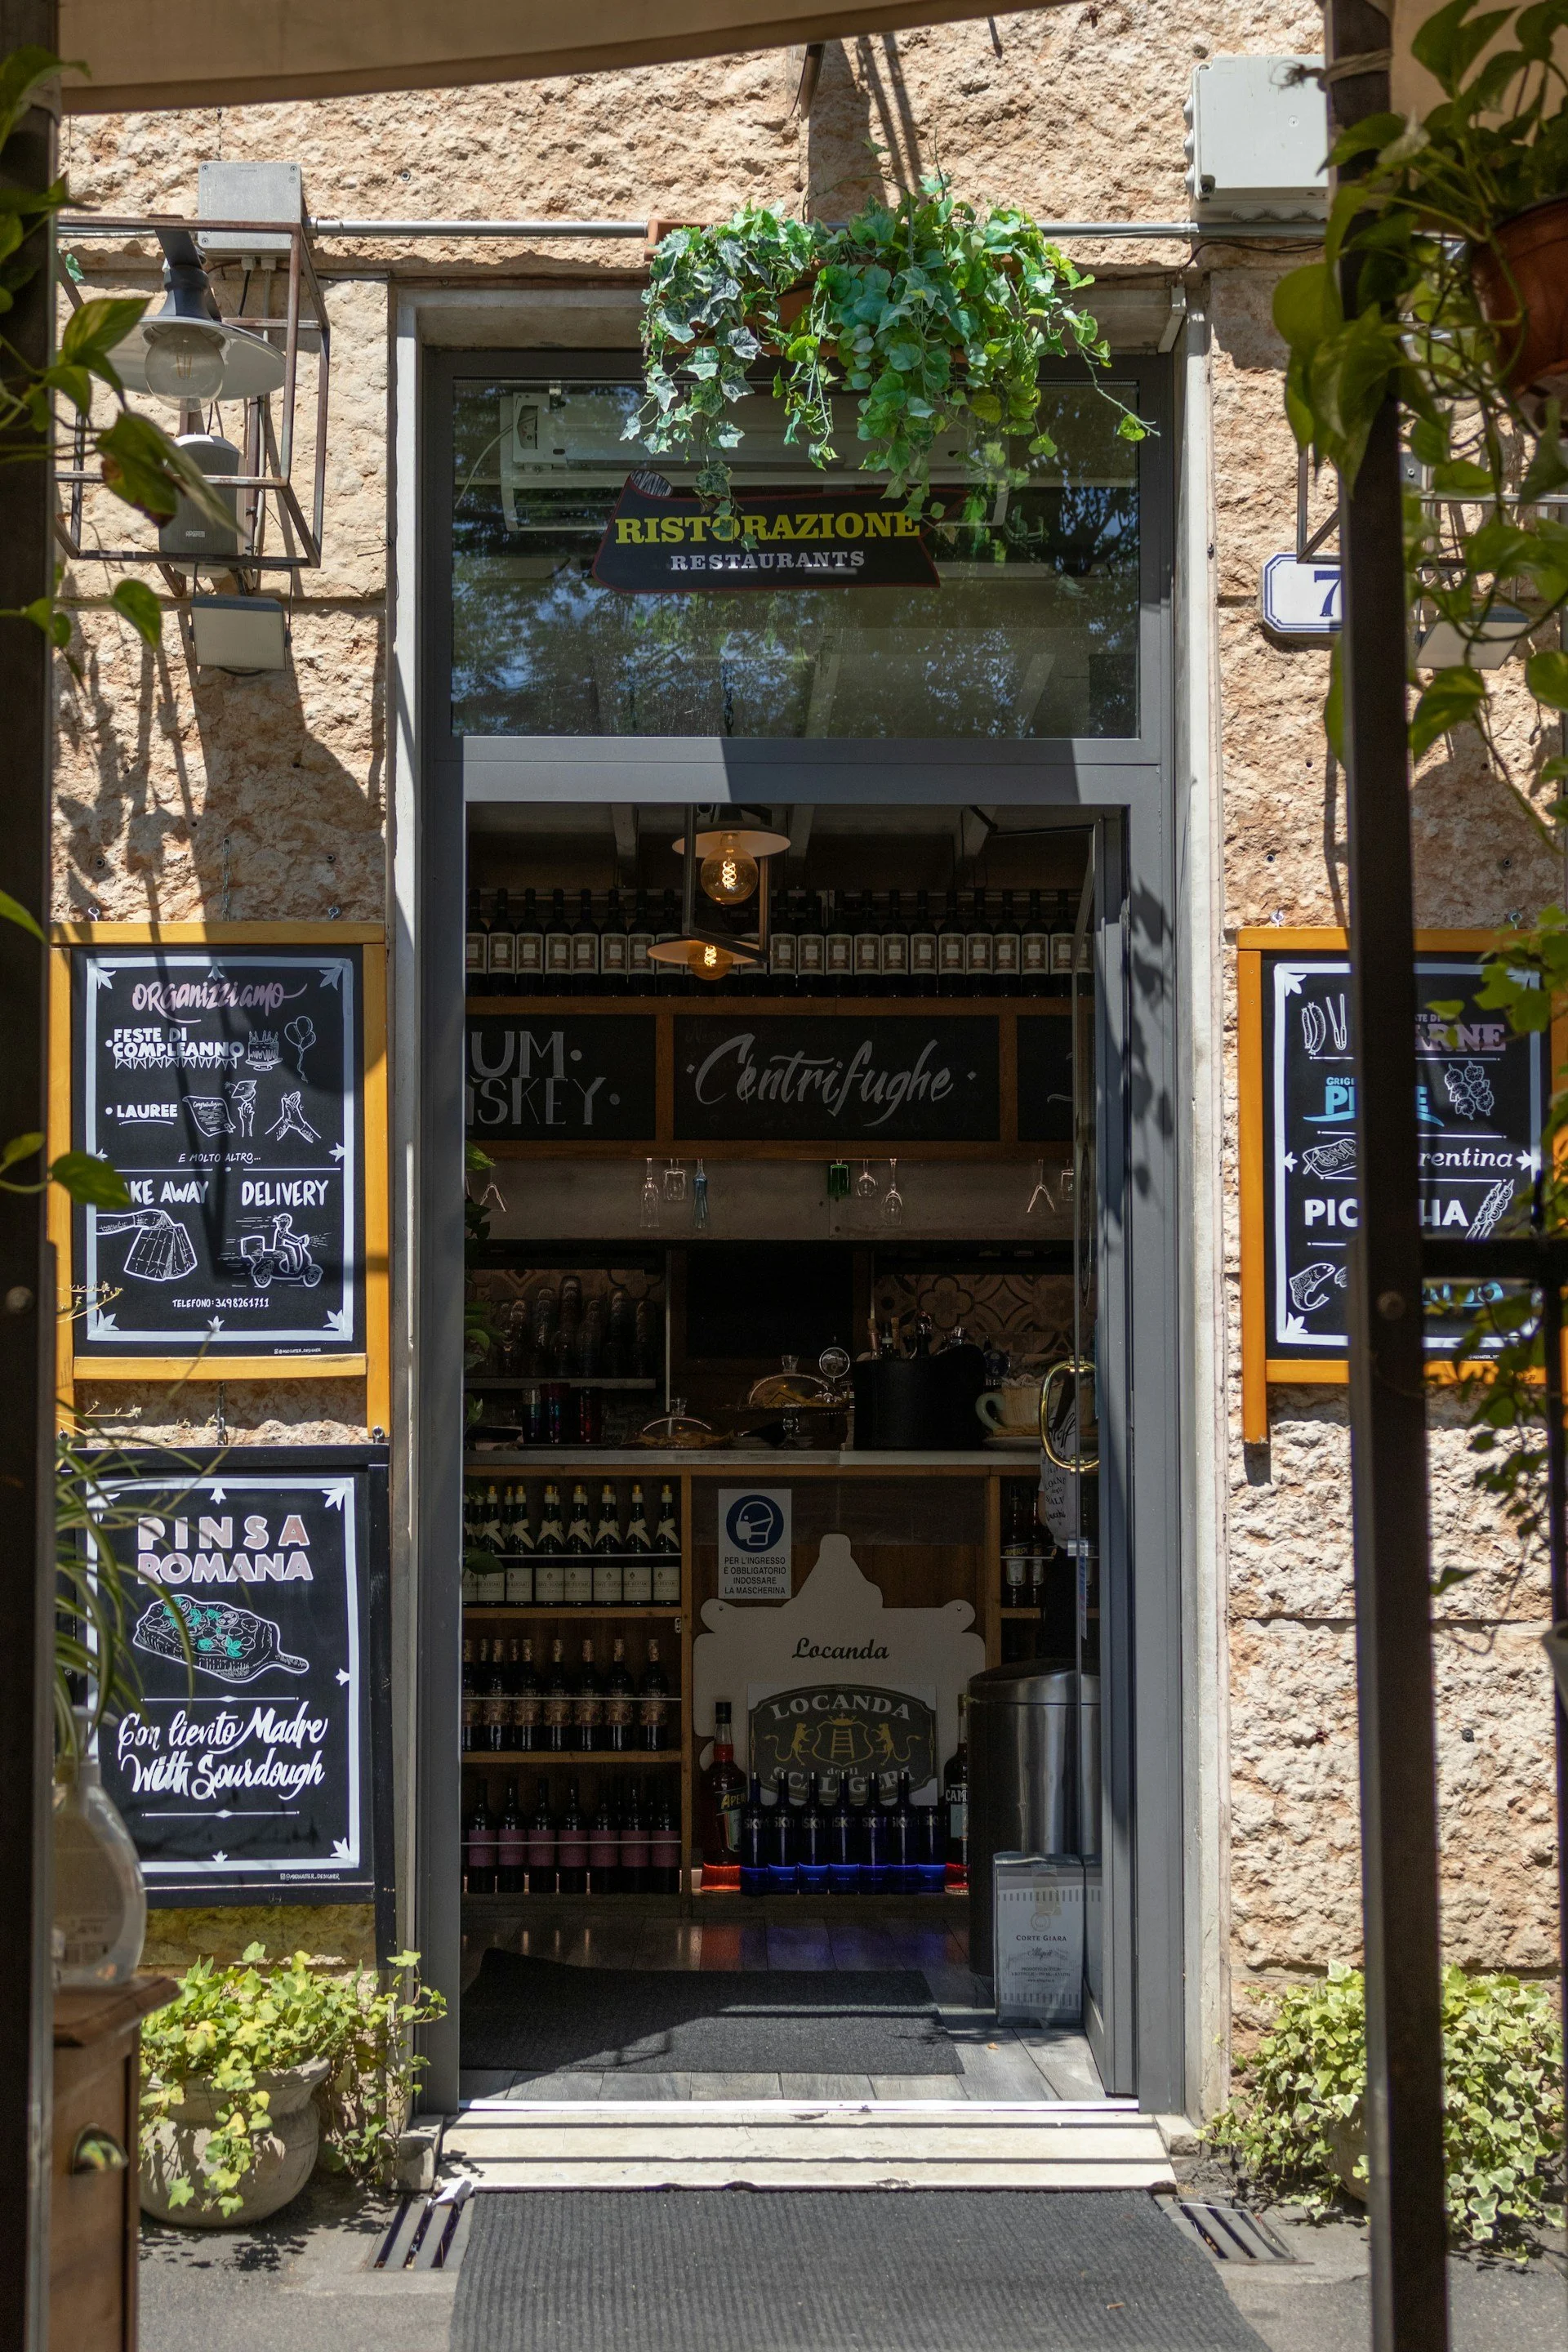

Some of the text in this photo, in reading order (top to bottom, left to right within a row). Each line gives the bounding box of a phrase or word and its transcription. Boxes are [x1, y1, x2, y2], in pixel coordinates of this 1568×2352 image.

[615, 511, 920, 545] RISTORAZIONE
[670, 550, 866, 572] RESTAURANTS
[1314, 570, 1341, 617] 7
[114, 1027, 187, 1043] FESTE DI
[112, 1041, 245, 1058] COMPLEANNO
[471, 1031, 564, 1079] UM
[695, 1032, 954, 1127] Centrifughe
[117, 1104, 177, 1118] LAUREE
[178, 1153, 186, 1163] E
[189, 1152, 221, 1163] MOLTO
[1419, 1147, 1513, 1168] rentina
[124, 1178, 209, 1205] KE AWAY
[242, 1179, 329, 1207] DELIVERY
[1304, 1198, 1469, 1227] PICHA
[138, 1515, 310, 1551] PINSA
[138, 1551, 314, 1584] ROMANA
[724, 1557, 786, 1565] PER L'INGRESSO
[730, 1566, 786, 1575] OBBLIGATORIO
[733, 1576, 777, 1584] INDOSSARE
[736, 1586, 786, 1594] MASCHERINA
[791, 1637, 890, 1659] Locanda
[769, 1694, 911, 1721] LOCANDA
[118, 1713, 161, 1761] Con
[207, 1701, 328, 1754] Madre
[120, 1747, 326, 1801] With Sourdough
